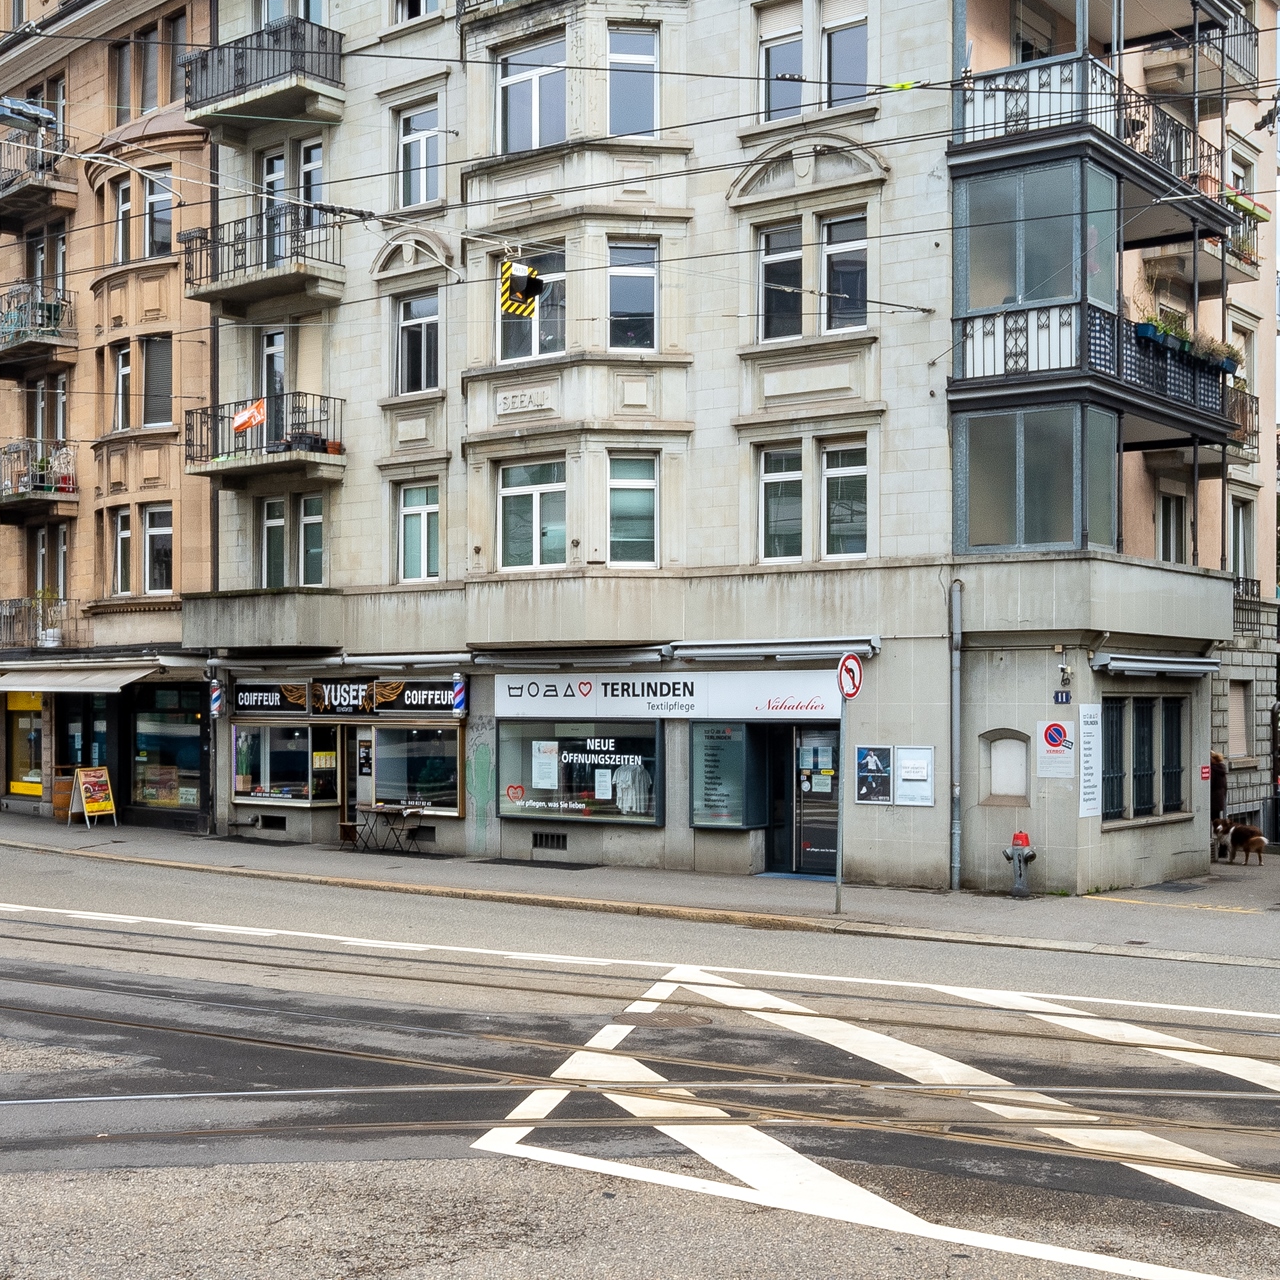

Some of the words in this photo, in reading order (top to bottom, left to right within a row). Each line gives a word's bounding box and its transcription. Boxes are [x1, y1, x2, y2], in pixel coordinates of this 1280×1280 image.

[322, 684, 368, 705] YUSEF
[601, 682, 694, 697] TERLINDEN
[238, 692, 280, 705] COIFFEUR
[404, 690, 455, 705] COIFFEUR
[755, 696, 825, 711] Nähatelier
[1058, 692, 1066, 702] 11
[647, 702, 695, 711] Textilpflege
[586, 739, 615, 751] NEUE
[562, 751, 642, 765] ÖFFNUNGSZEITEN
[526, 800, 547, 808] pflegen,
